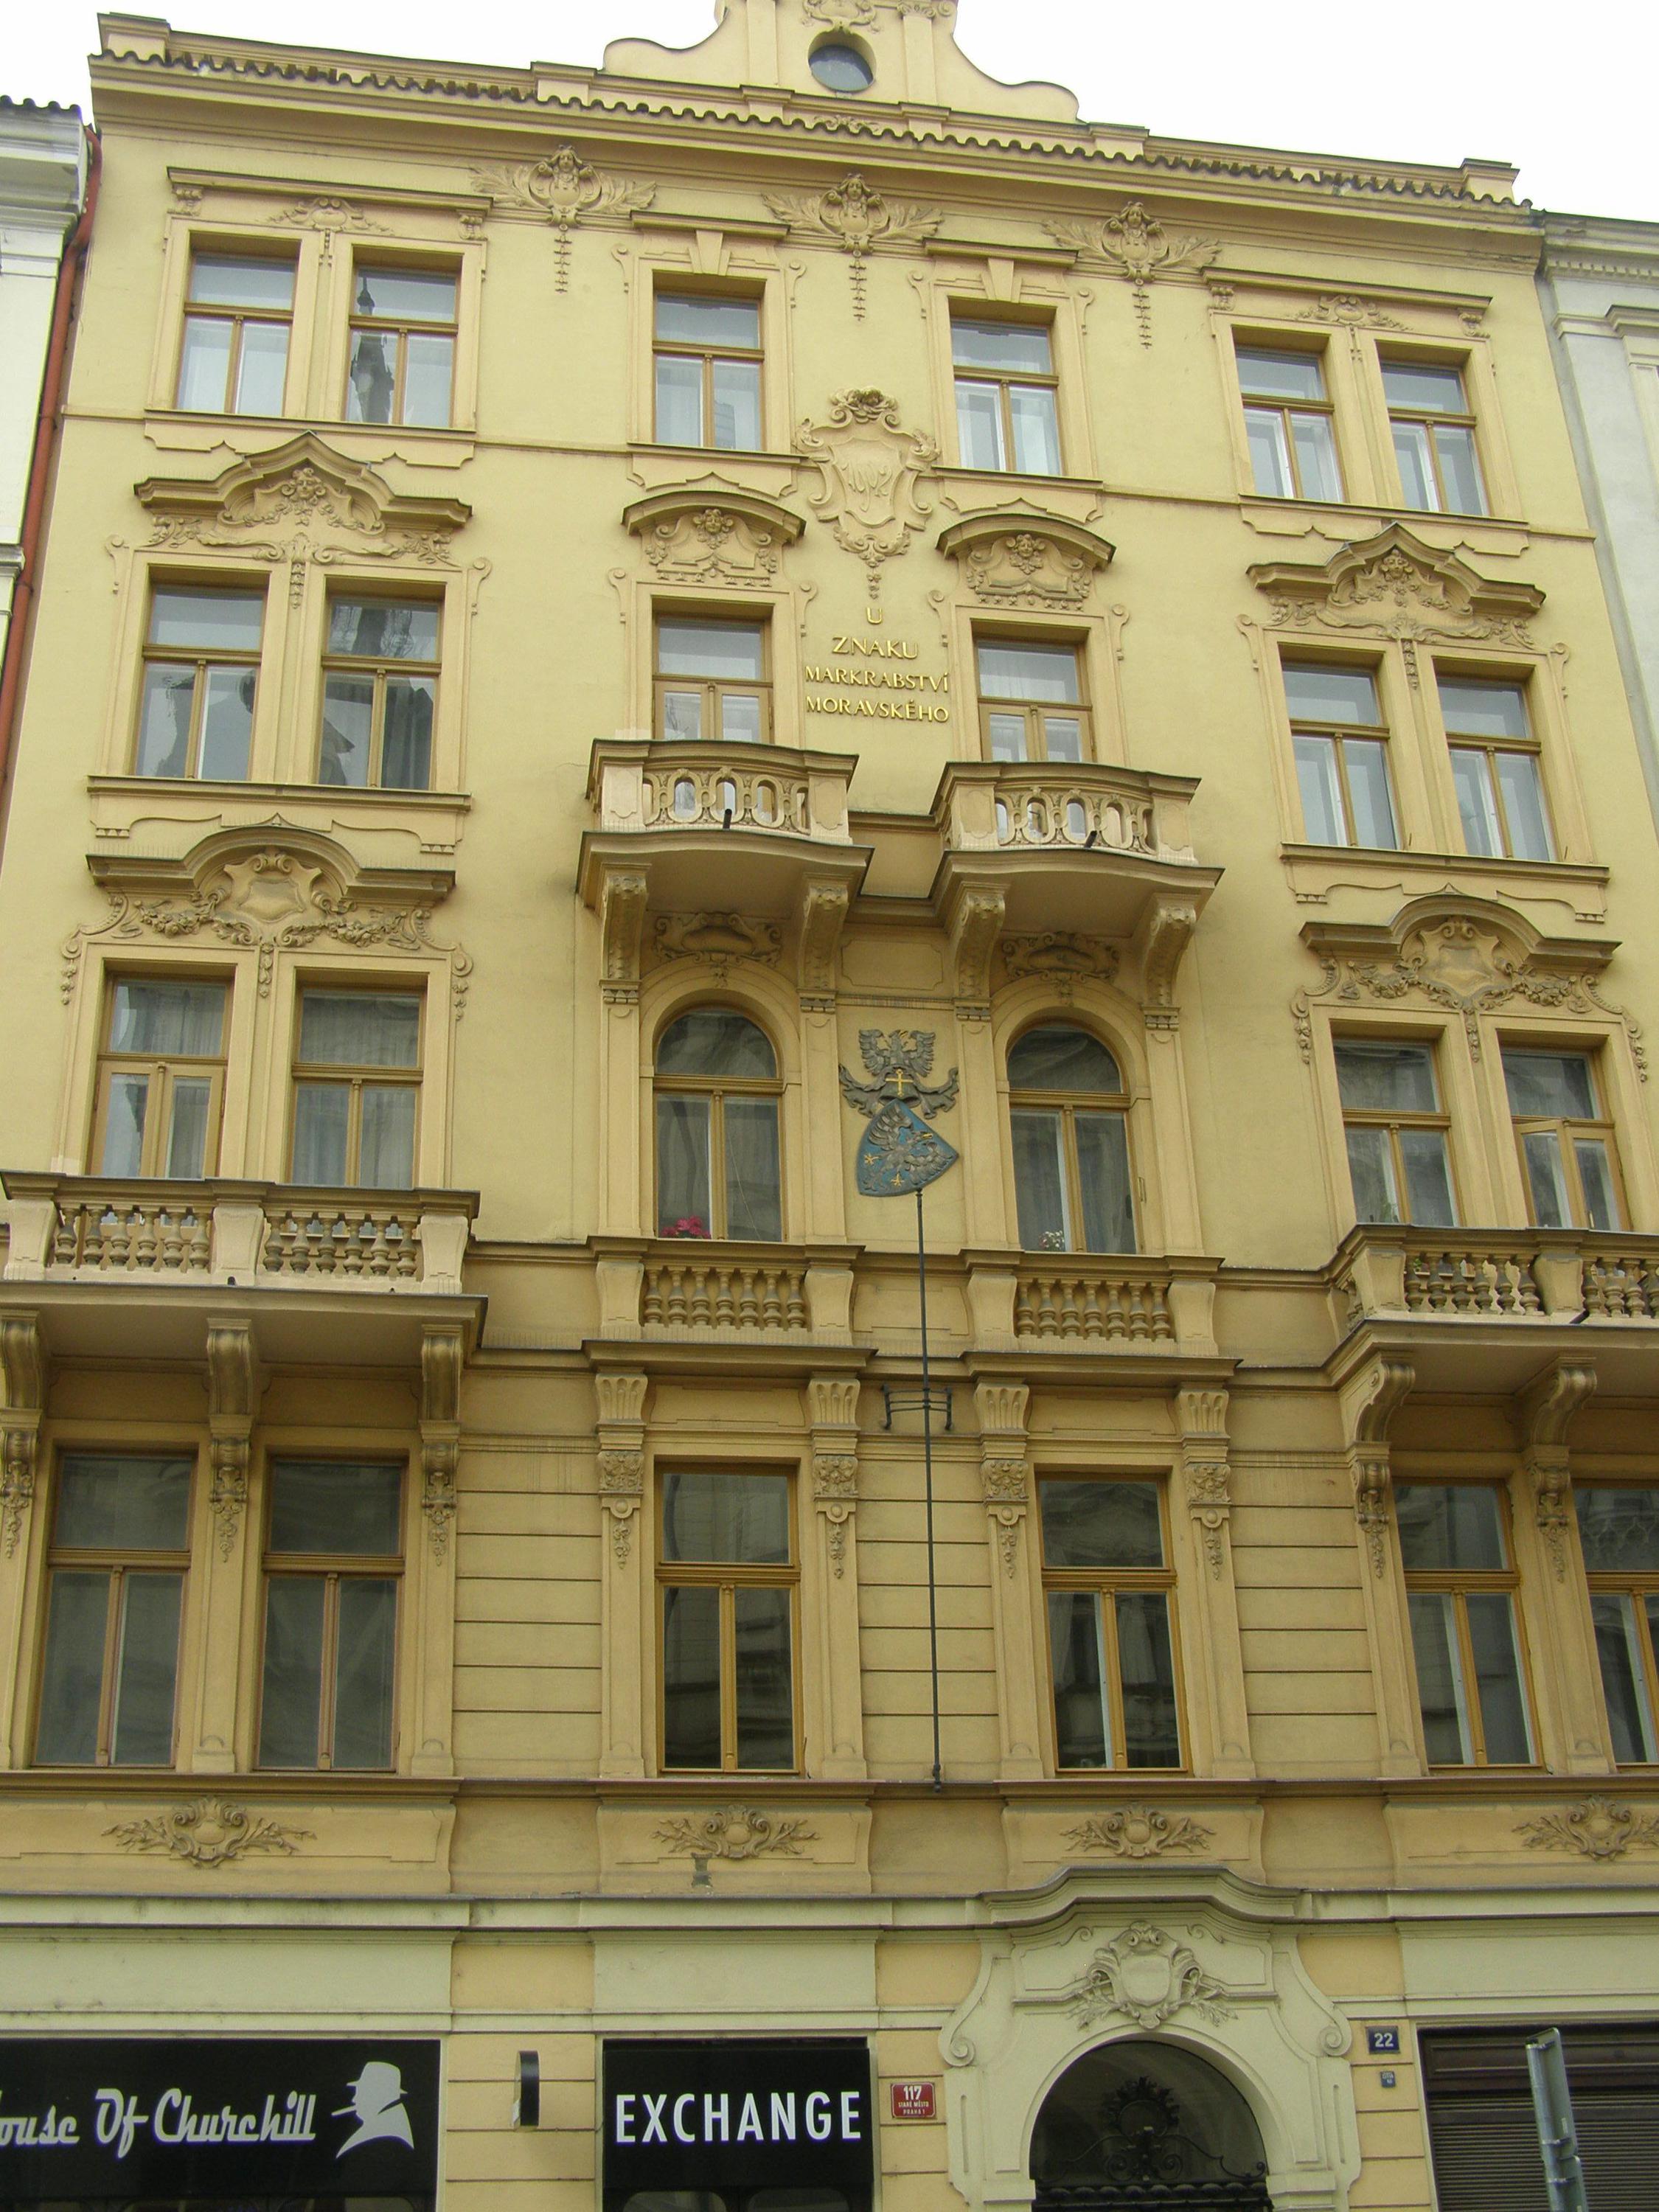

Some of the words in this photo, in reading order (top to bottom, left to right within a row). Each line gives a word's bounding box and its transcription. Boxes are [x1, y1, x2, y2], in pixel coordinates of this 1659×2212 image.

[866, 607, 883, 625] U
[832, 636, 919, 659] ZNAKU
[805, 666, 949, 692] MARKRABSTVÍ
[807, 696, 949, 723] MORAVSKÉHO
[1374, 2032, 1394, 2048] 22
[903, 2085, 922, 2100] 117
[0, 2090, 80, 2146] ouse
[95, 2088, 148, 2159] Of
[153, 2088, 316, 2143] Churchill
[615, 2091, 862, 2143] EXCHANGE
